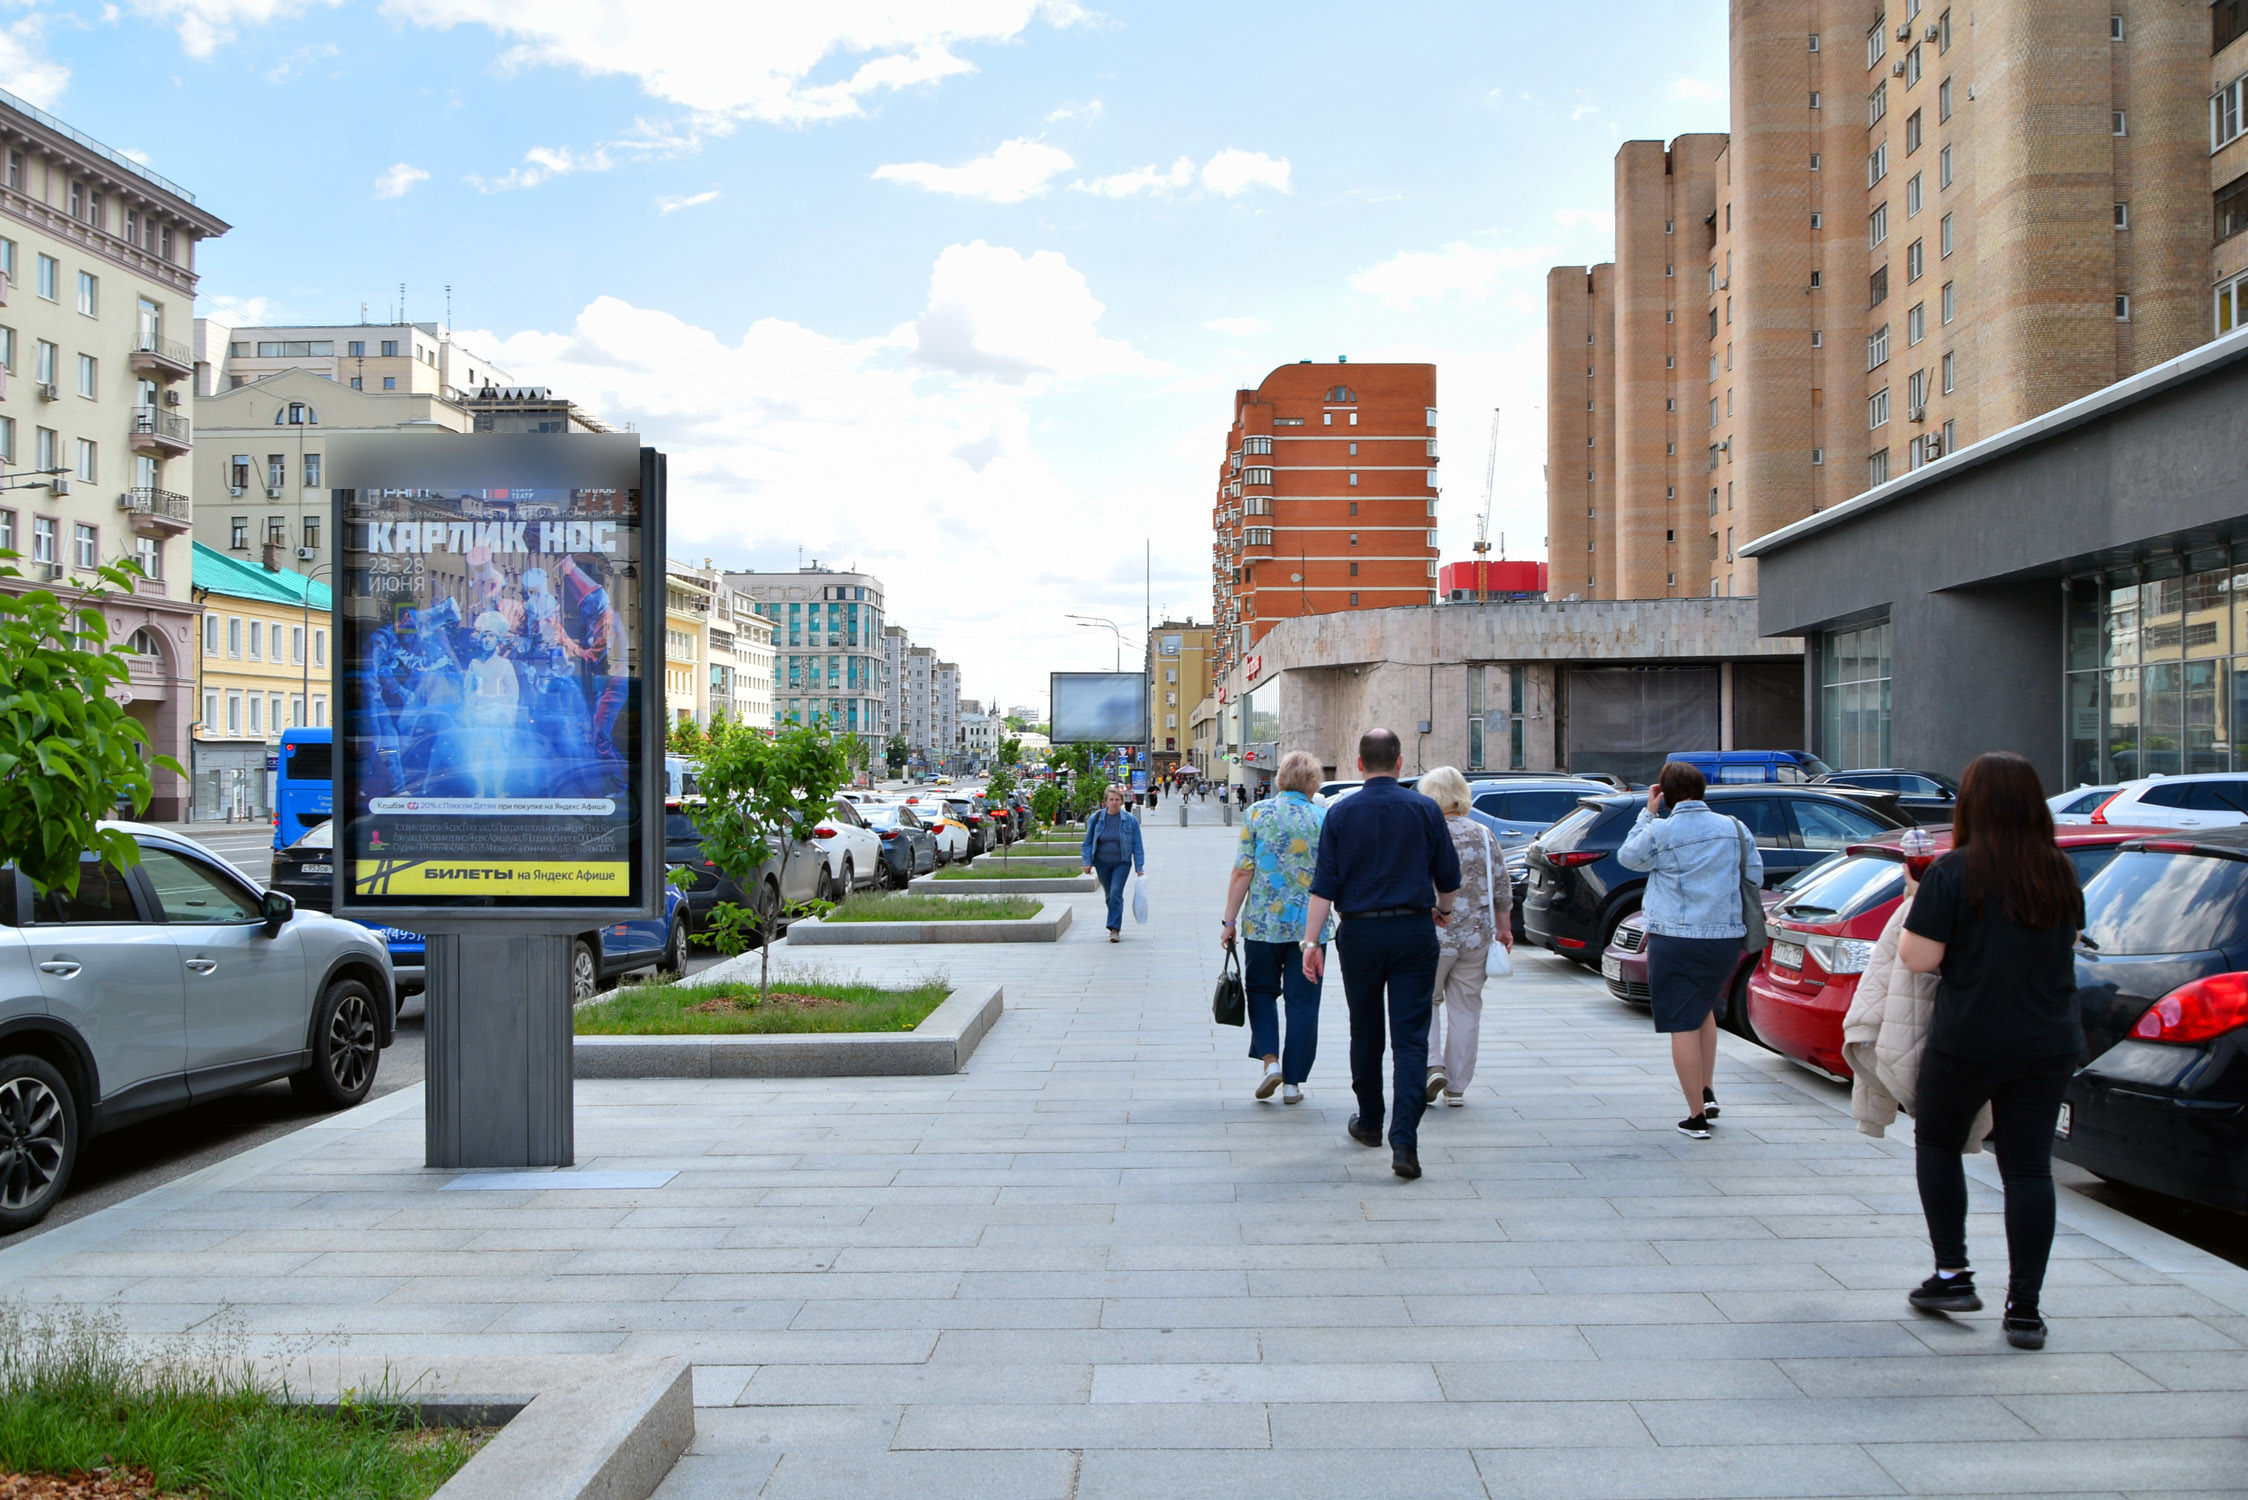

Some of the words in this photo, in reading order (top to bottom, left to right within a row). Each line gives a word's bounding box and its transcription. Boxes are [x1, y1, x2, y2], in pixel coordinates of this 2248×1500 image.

[369, 509, 422, 519] САЗОЧНЫЙ
[368, 521, 528, 553] КАРЛИК
[540, 520, 616, 553] НОС
[368, 576, 425, 592] ИЮНЯ
[377, 802, 405, 810] Кешбэк
[443, 802, 472, 810] Плюсом
[473, 802, 497, 811] Детям
[498, 803, 512, 811] при
[513, 803, 543, 811] покупке
[555, 802, 580, 811] Яндекс
[581, 801, 607, 811] Афише
[424, 868, 513, 880] БИЛЕТЫ
[517, 872, 531, 880] на
[533, 869, 574, 883] Яндекс
[576, 869, 615, 883] Афише
